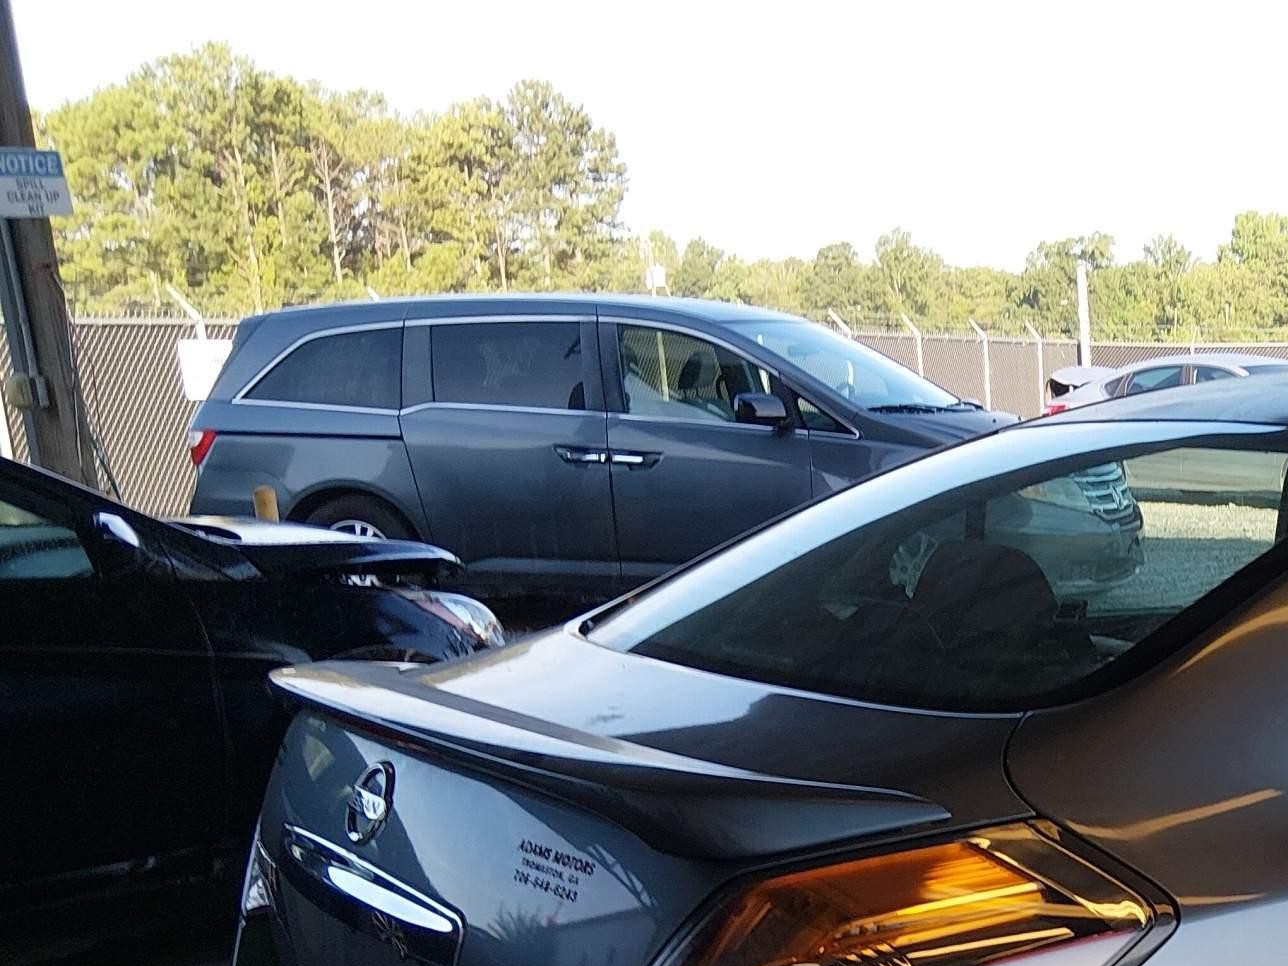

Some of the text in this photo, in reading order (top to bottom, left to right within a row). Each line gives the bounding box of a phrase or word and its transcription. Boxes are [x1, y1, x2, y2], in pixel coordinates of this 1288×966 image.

[16, 177, 45, 189] SPILL
[7, 190, 60, 203] CLEAN UP
[518, 839, 596, 876] ADAMS MOTORS
